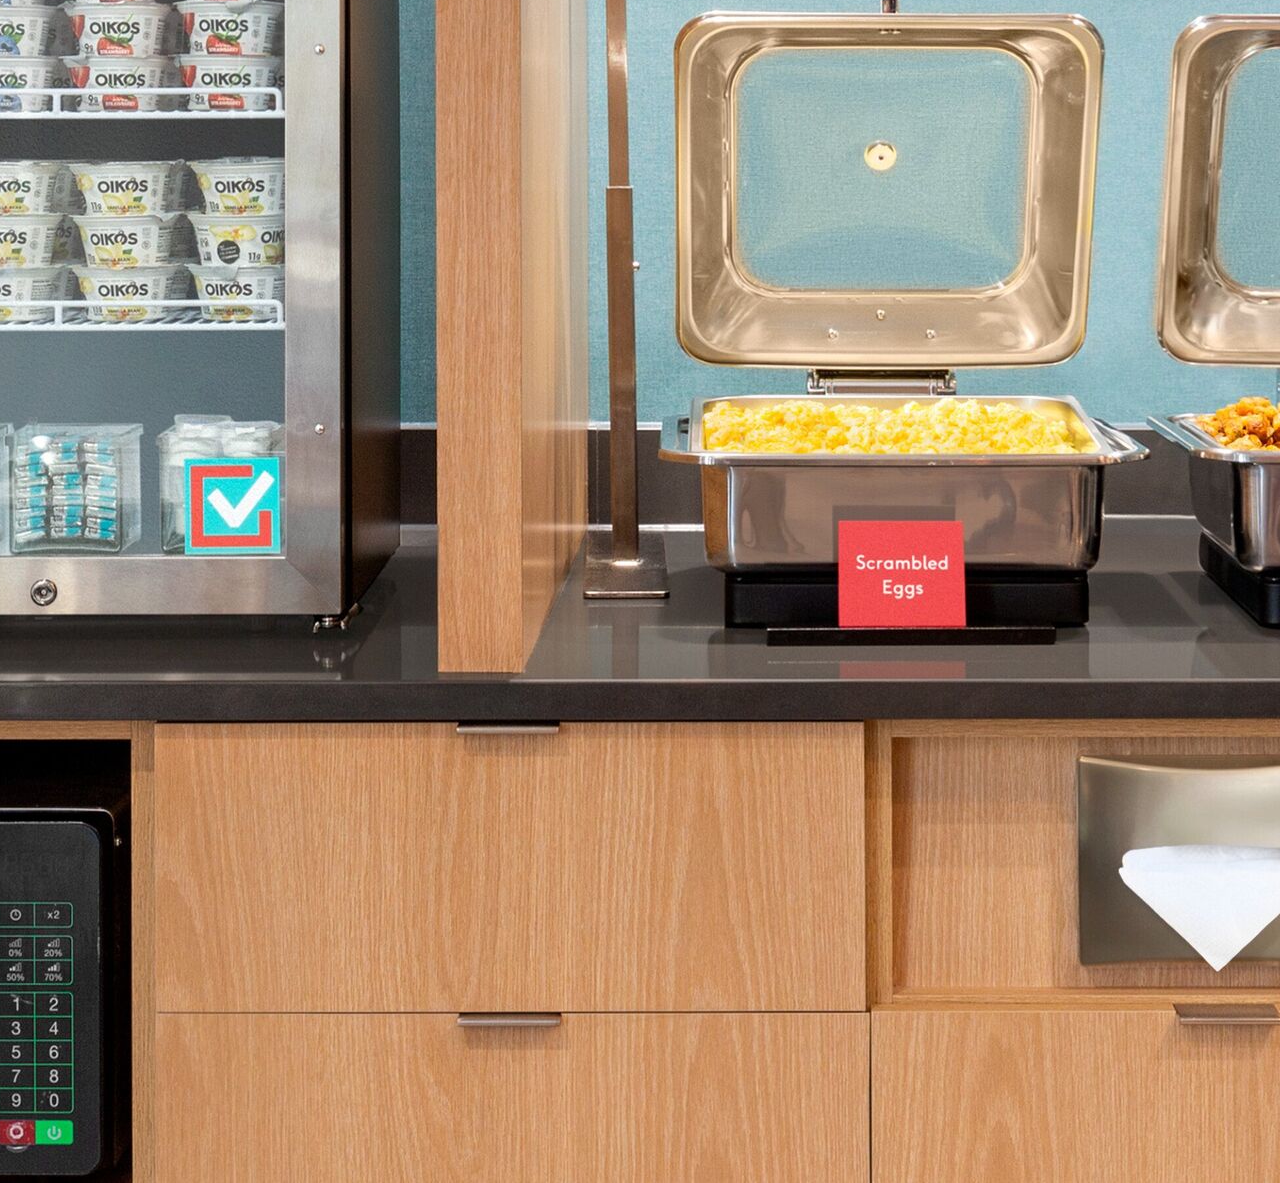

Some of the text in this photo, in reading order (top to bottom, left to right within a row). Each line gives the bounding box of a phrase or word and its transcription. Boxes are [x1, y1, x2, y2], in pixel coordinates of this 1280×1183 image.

[90, 21, 140, 35] OIKOS
[199, 19, 249, 33] OIKOS
[95, 73, 146, 87] OIKOS
[201, 72, 251, 86] OIKOS
[97, 180, 148, 193] OIKOS
[215, 180, 265, 193] OIKOS
[90, 232, 138, 246] OIKOS
[98, 283, 148, 297] OIKOS
[205, 283, 253, 297] OIKOS
[856, 554, 949, 571] Scrambled
[882, 579, 924, 600] Eggs
[8, 949, 23, 957] 0%
[44, 949, 63, 957] 20%
[6, 973, 25, 982] 50%
[44, 973, 63, 982] 70%
[12, 998, 20, 1011] 1
[49, 998, 59, 1011] 2
[11, 1021, 21, 1035] 3
[48, 1021, 59, 1035] 4
[11, 1046, 21, 1059] 5
[49, 1045, 59, 1059] 6
[11, 1070, 21, 1083] 7
[49, 1069, 59, 1083] 8
[11, 1093, 21, 1107] 9
[49, 1093, 59, 1107] 0
